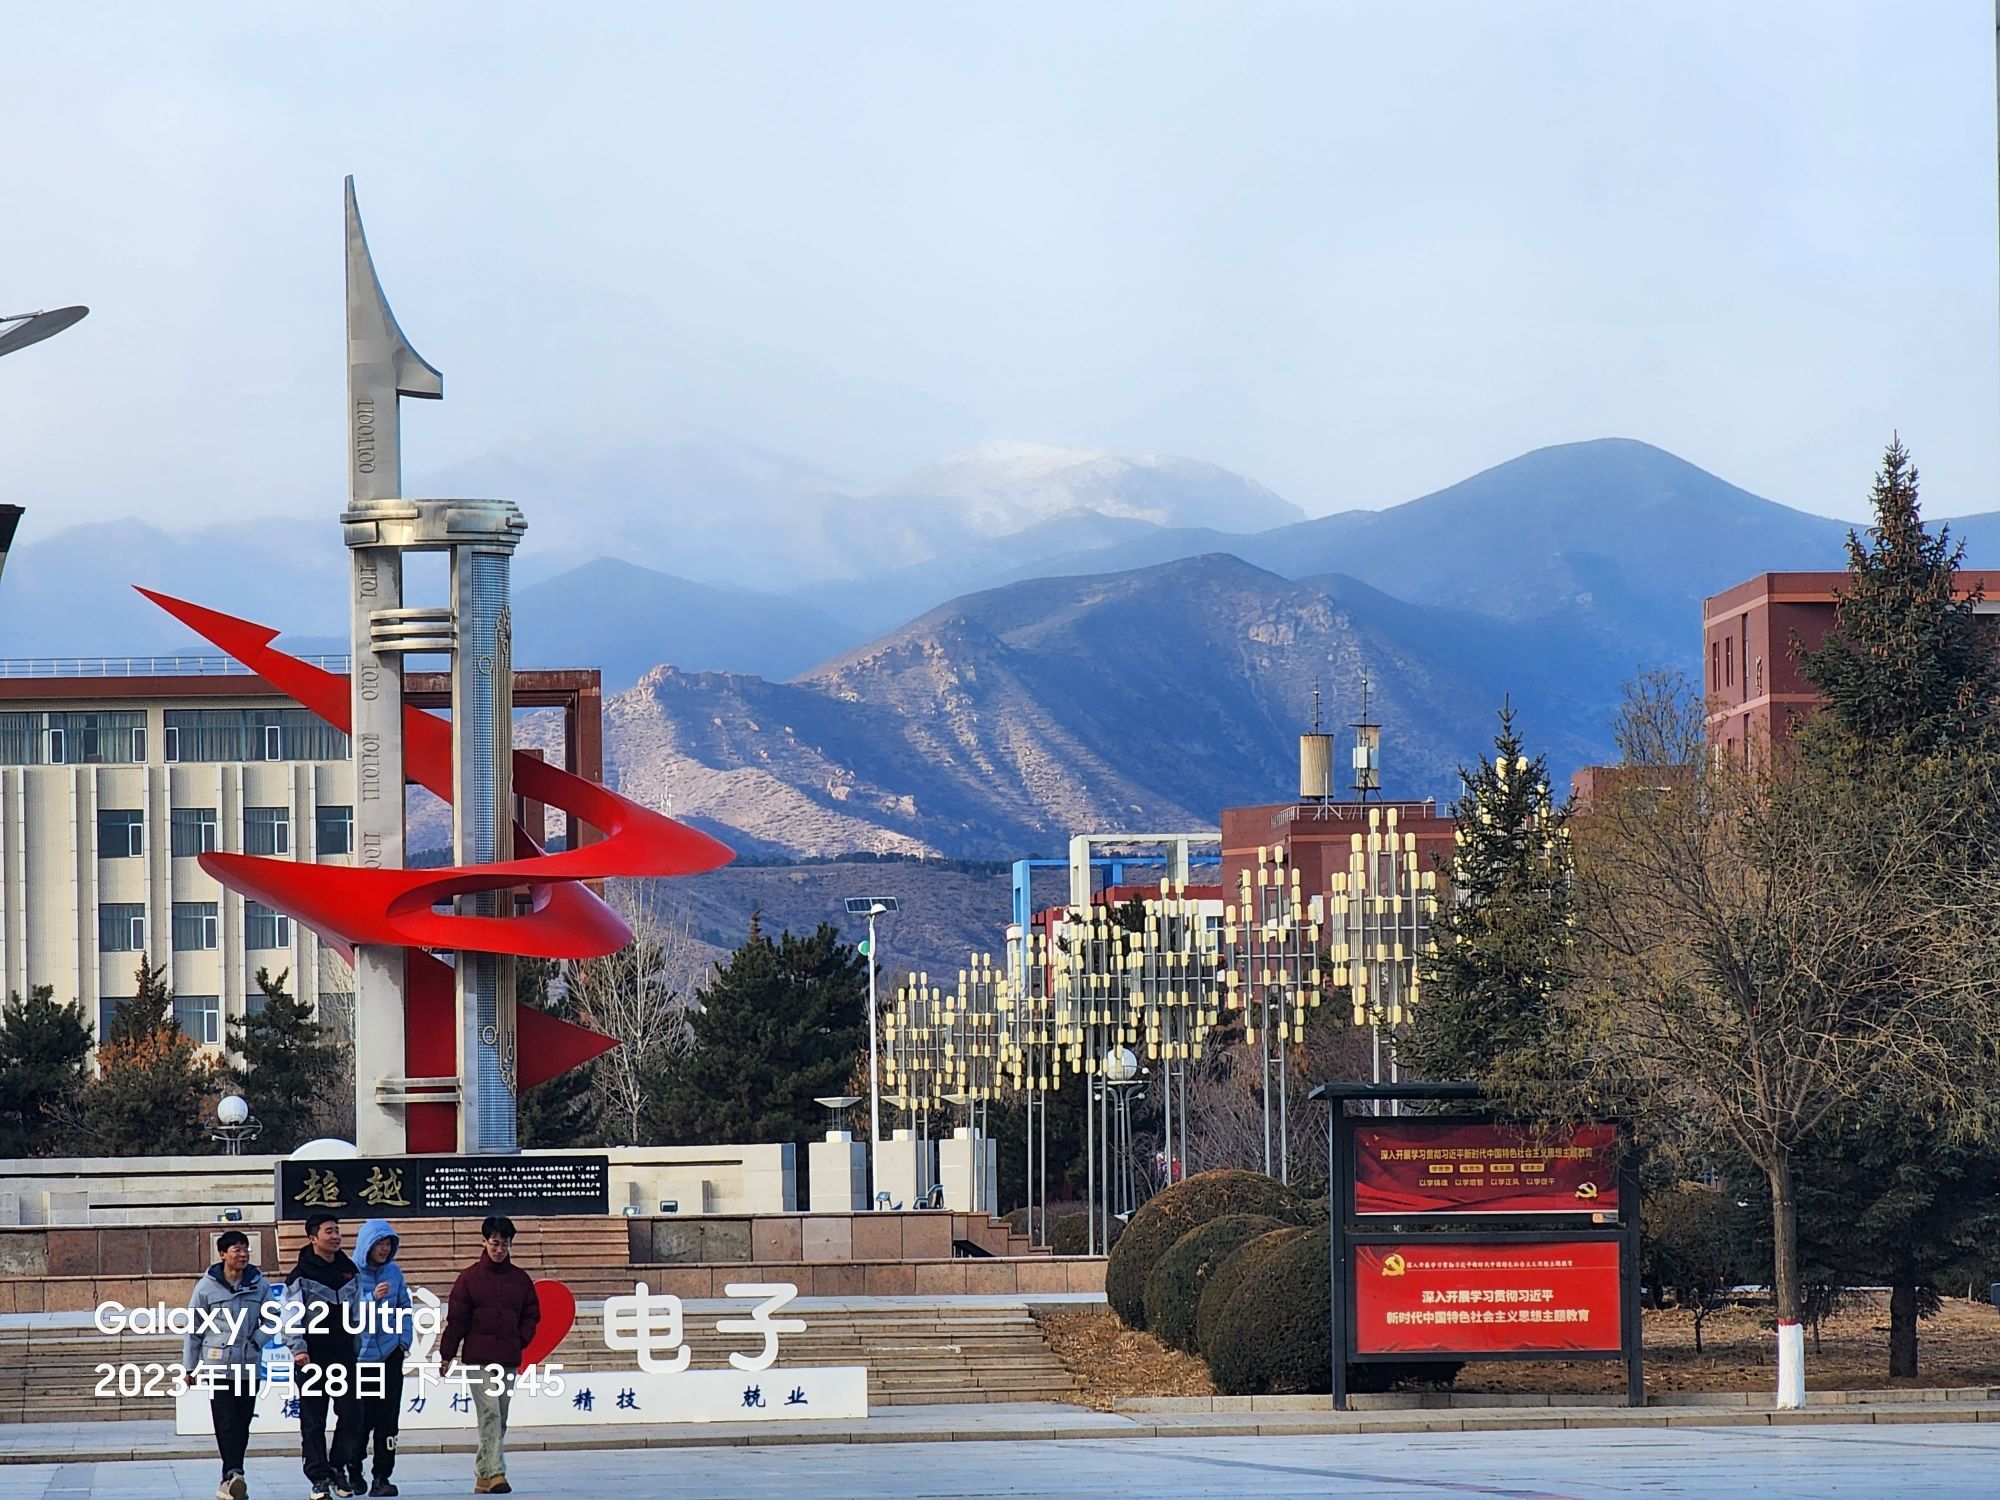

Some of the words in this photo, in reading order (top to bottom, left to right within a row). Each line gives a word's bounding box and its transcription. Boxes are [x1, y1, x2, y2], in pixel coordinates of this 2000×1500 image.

[294, 1166, 411, 1208] 超越
[1421, 1289, 1554, 1304] 深入开展学习贯彻习近平
[603, 1281, 808, 1374] 电子
[1386, 1309, 1590, 1324] 新时代中国特色社会主义思想主题教育
